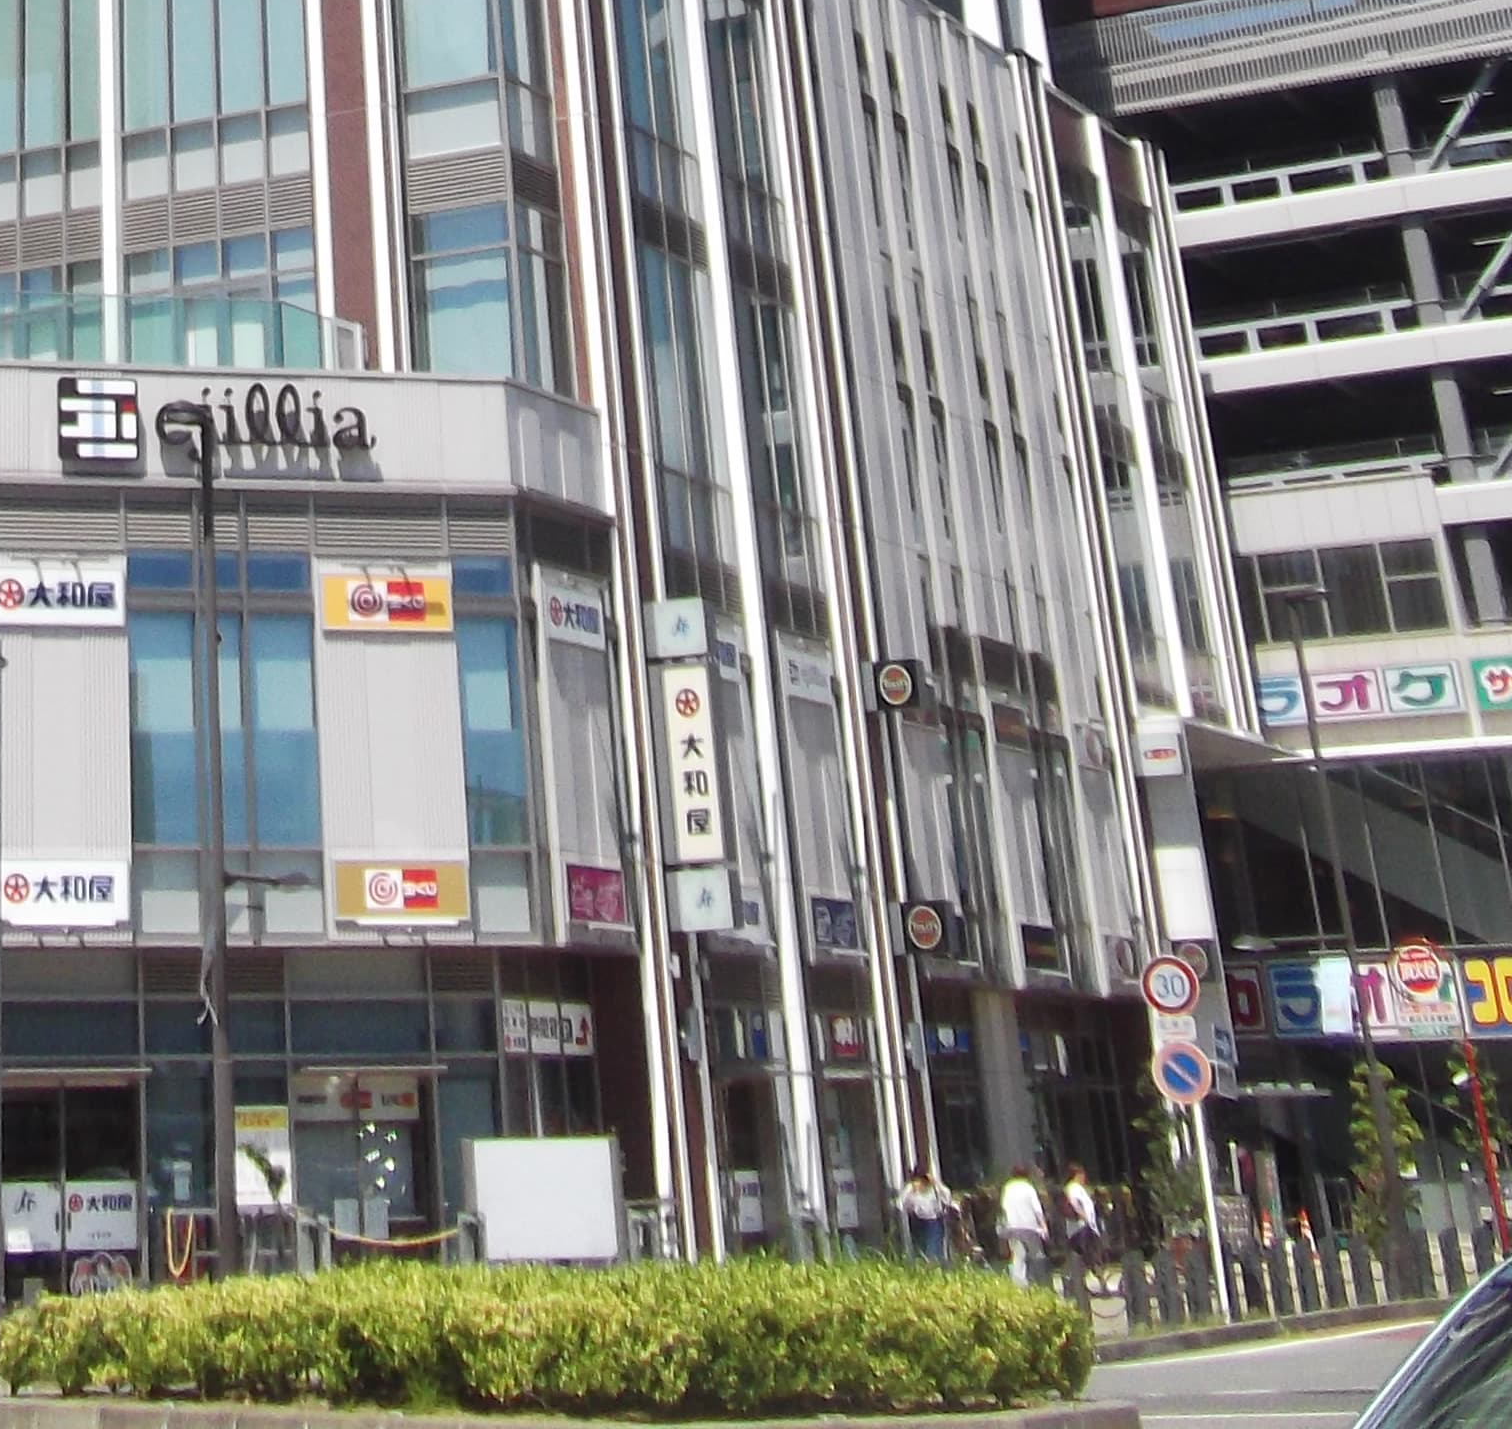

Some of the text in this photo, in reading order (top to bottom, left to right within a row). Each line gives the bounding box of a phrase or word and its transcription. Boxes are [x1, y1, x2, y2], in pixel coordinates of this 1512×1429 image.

[28, 580, 115, 609] 大和屋
[680, 732, 712, 836] 大和屋
[33, 876, 115, 903] 大和屋
[1155, 973, 1186, 998] 30
[86, 1193, 133, 1212] 大和屋
